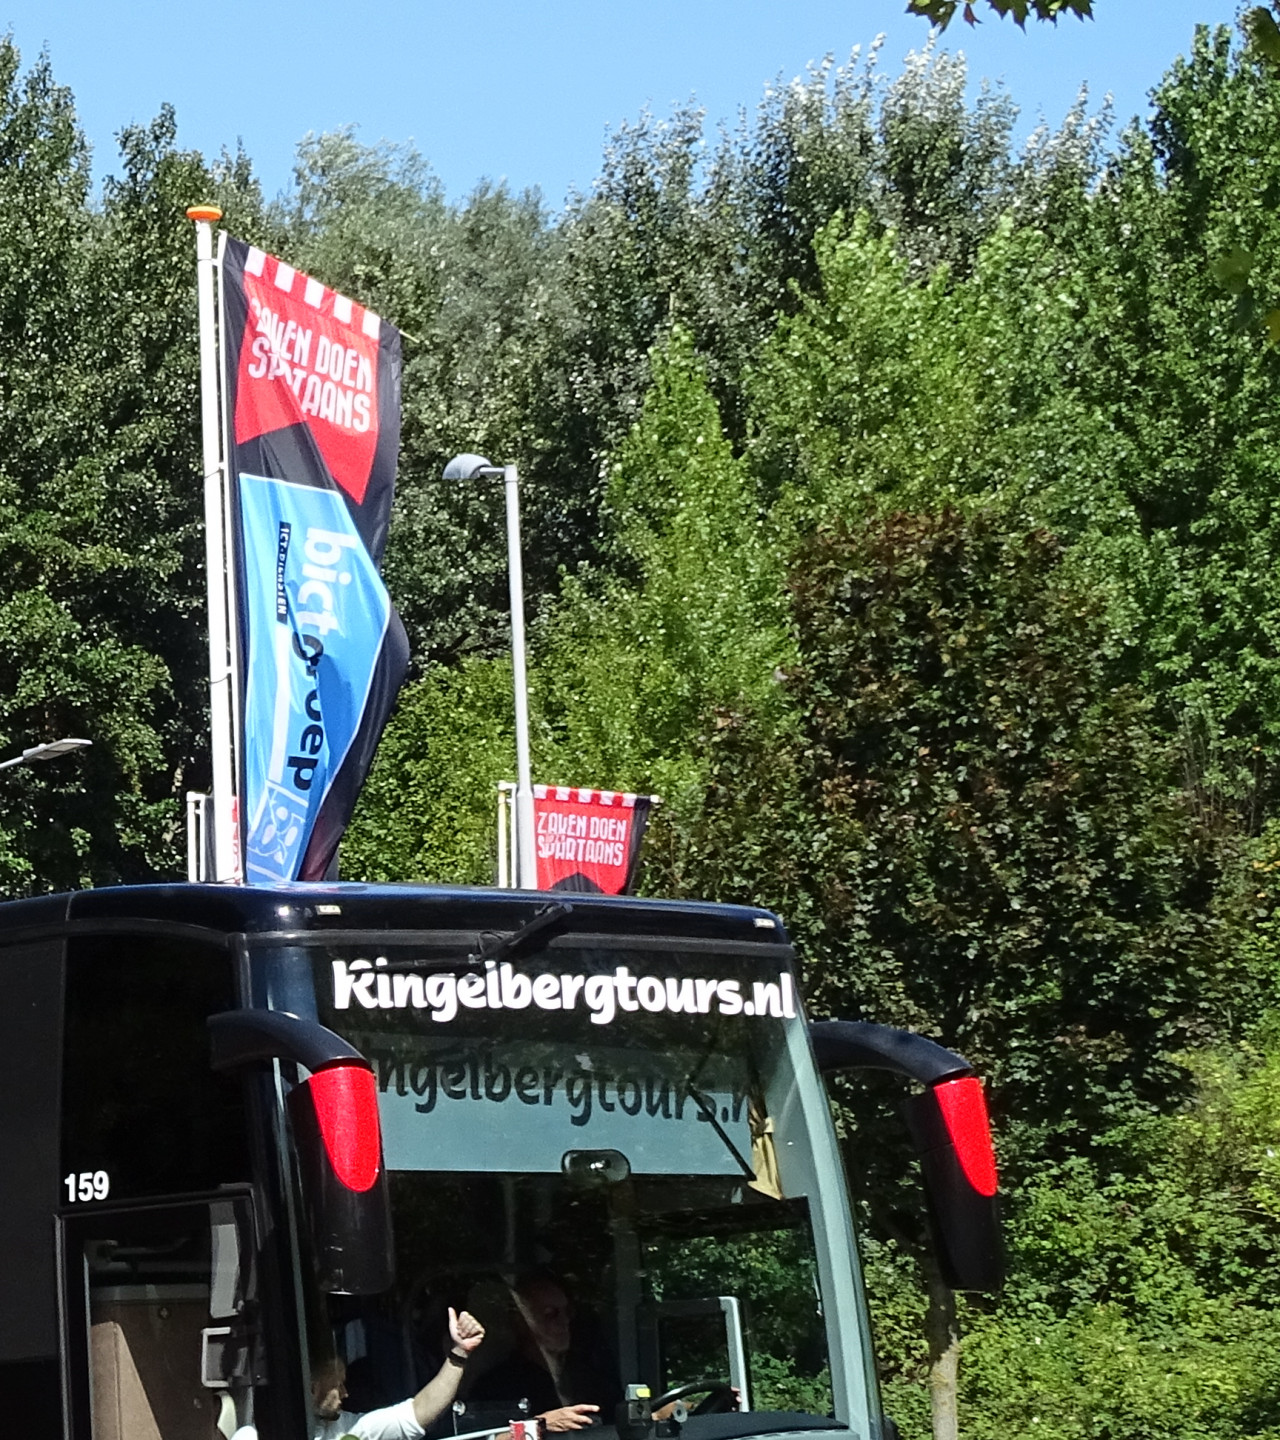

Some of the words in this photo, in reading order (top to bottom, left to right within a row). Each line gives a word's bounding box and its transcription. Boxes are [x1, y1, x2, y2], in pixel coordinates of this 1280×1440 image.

[314, 335, 372, 394] DOEN
[589, 816, 627, 842] DOEN
[64, 1170, 110, 1202] 159
